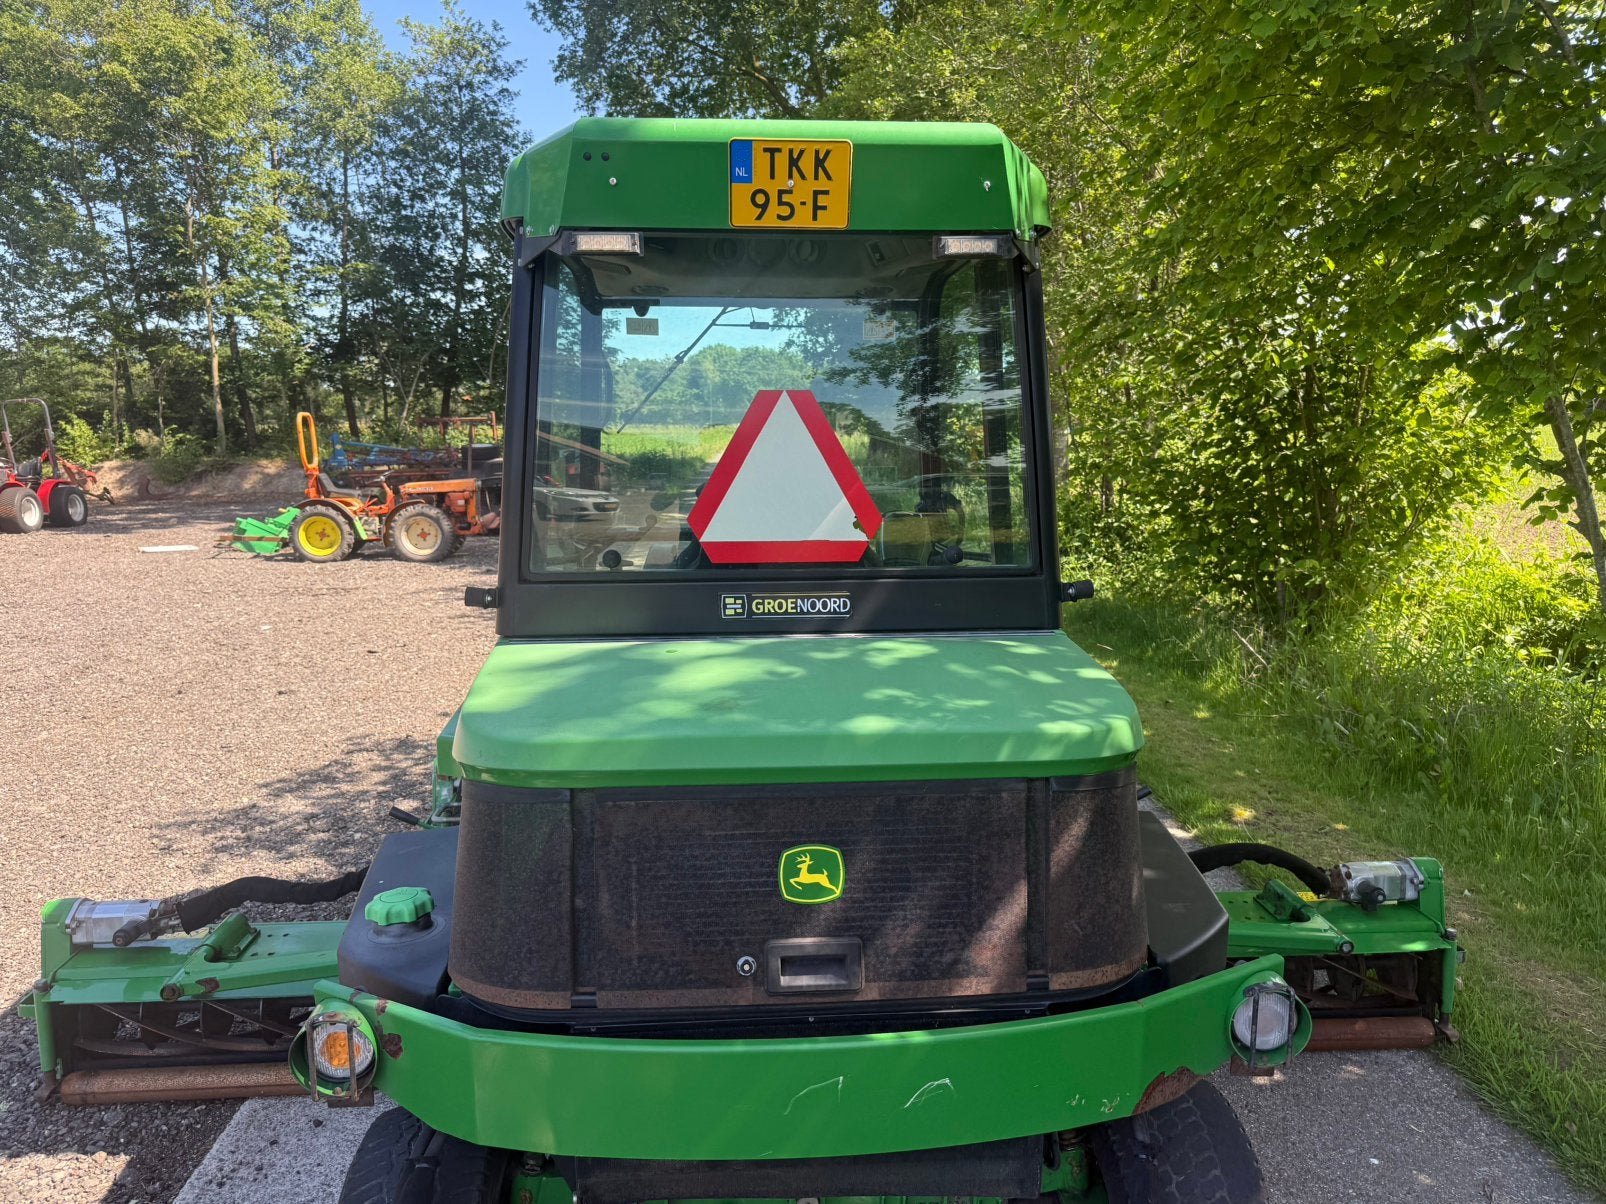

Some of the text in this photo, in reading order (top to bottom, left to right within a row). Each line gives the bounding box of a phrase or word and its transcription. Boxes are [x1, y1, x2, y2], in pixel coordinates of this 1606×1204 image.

[735, 167, 748, 177] NL
[762, 147, 833, 181] TKK
[750, 188, 830, 222] 95-F
[751, 598, 850, 613] GROENOORD
